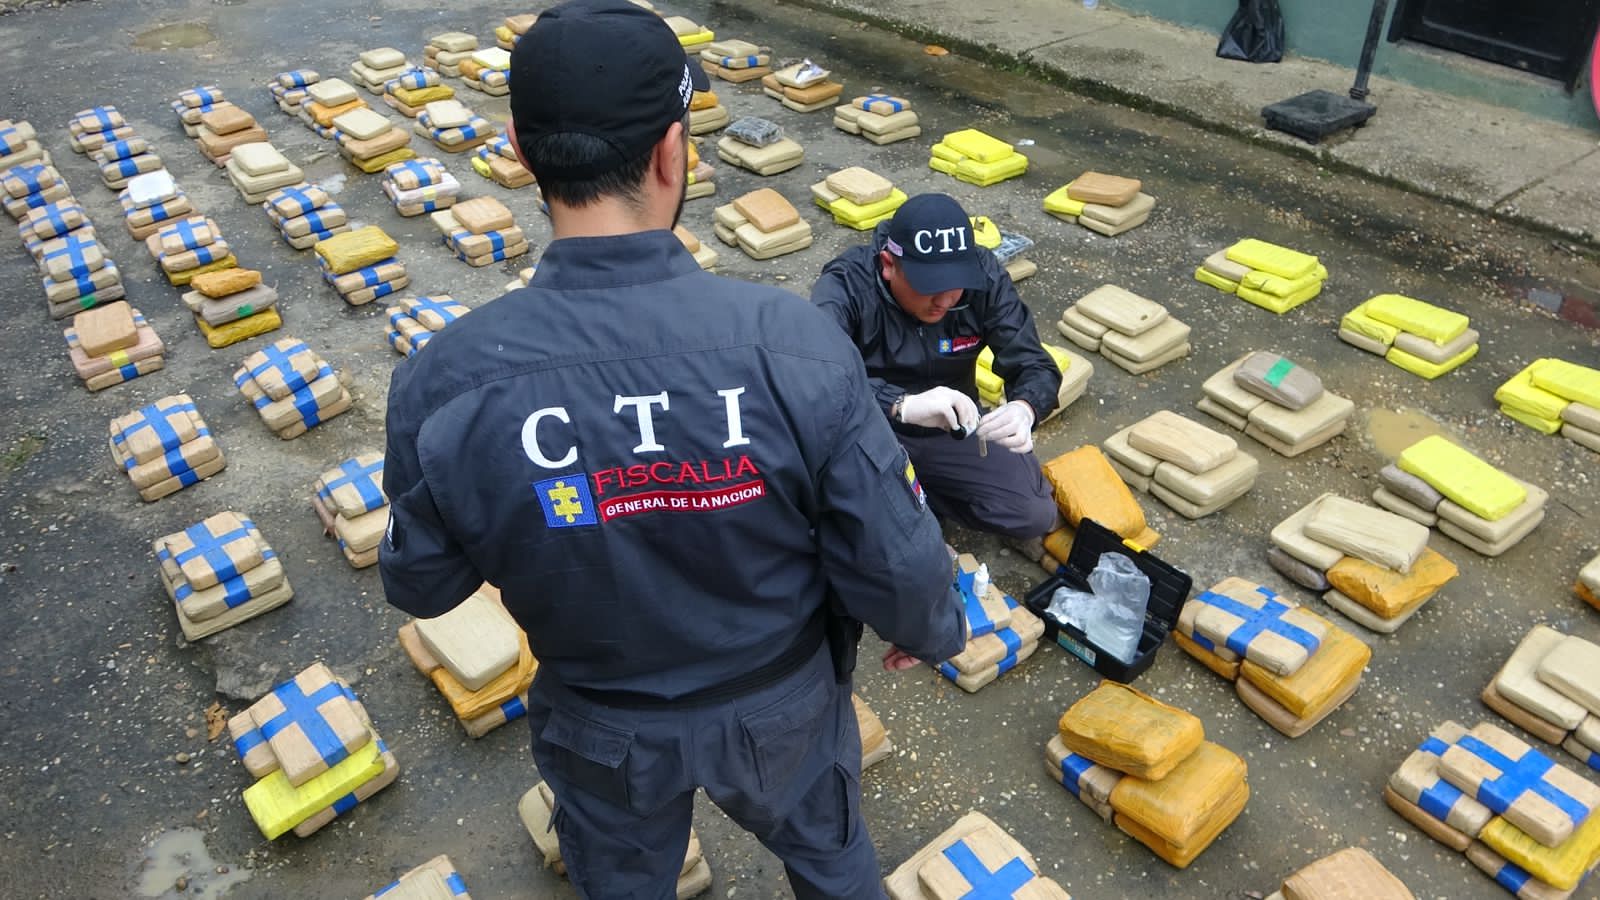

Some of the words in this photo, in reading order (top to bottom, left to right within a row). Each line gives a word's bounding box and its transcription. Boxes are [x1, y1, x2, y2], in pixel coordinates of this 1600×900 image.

[914, 227, 968, 254] CTI
[521, 386, 751, 469] CTI
[592, 455, 760, 495] FISCALIA
[606, 496, 668, 516] GENERAL
[671, 497, 689, 508] DE
[692, 496, 710, 508] LA
[711, 485, 762, 506] NACION
